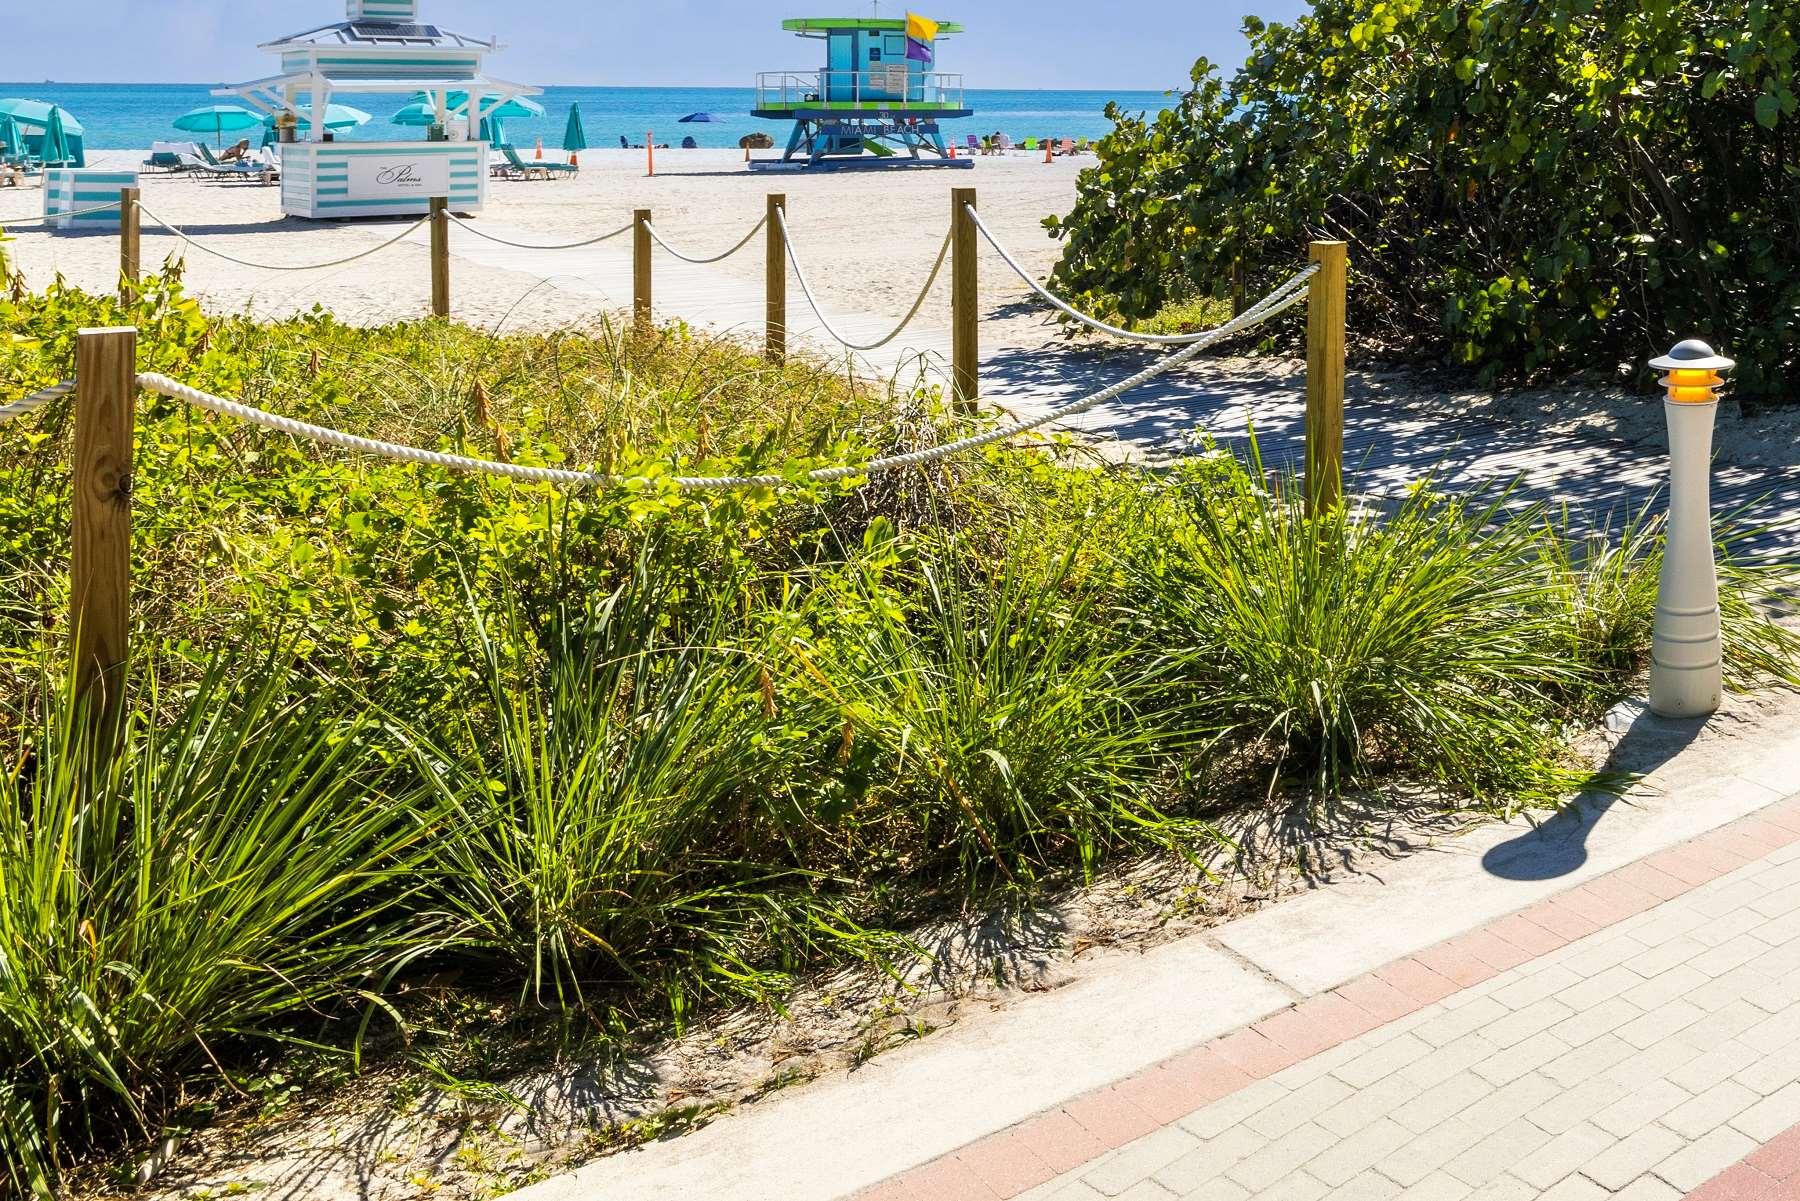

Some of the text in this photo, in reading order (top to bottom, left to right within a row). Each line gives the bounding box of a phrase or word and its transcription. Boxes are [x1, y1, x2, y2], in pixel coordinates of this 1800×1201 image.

[840, 124, 920, 136] MIAMI BEACH
[376, 163, 421, 185] Palms
